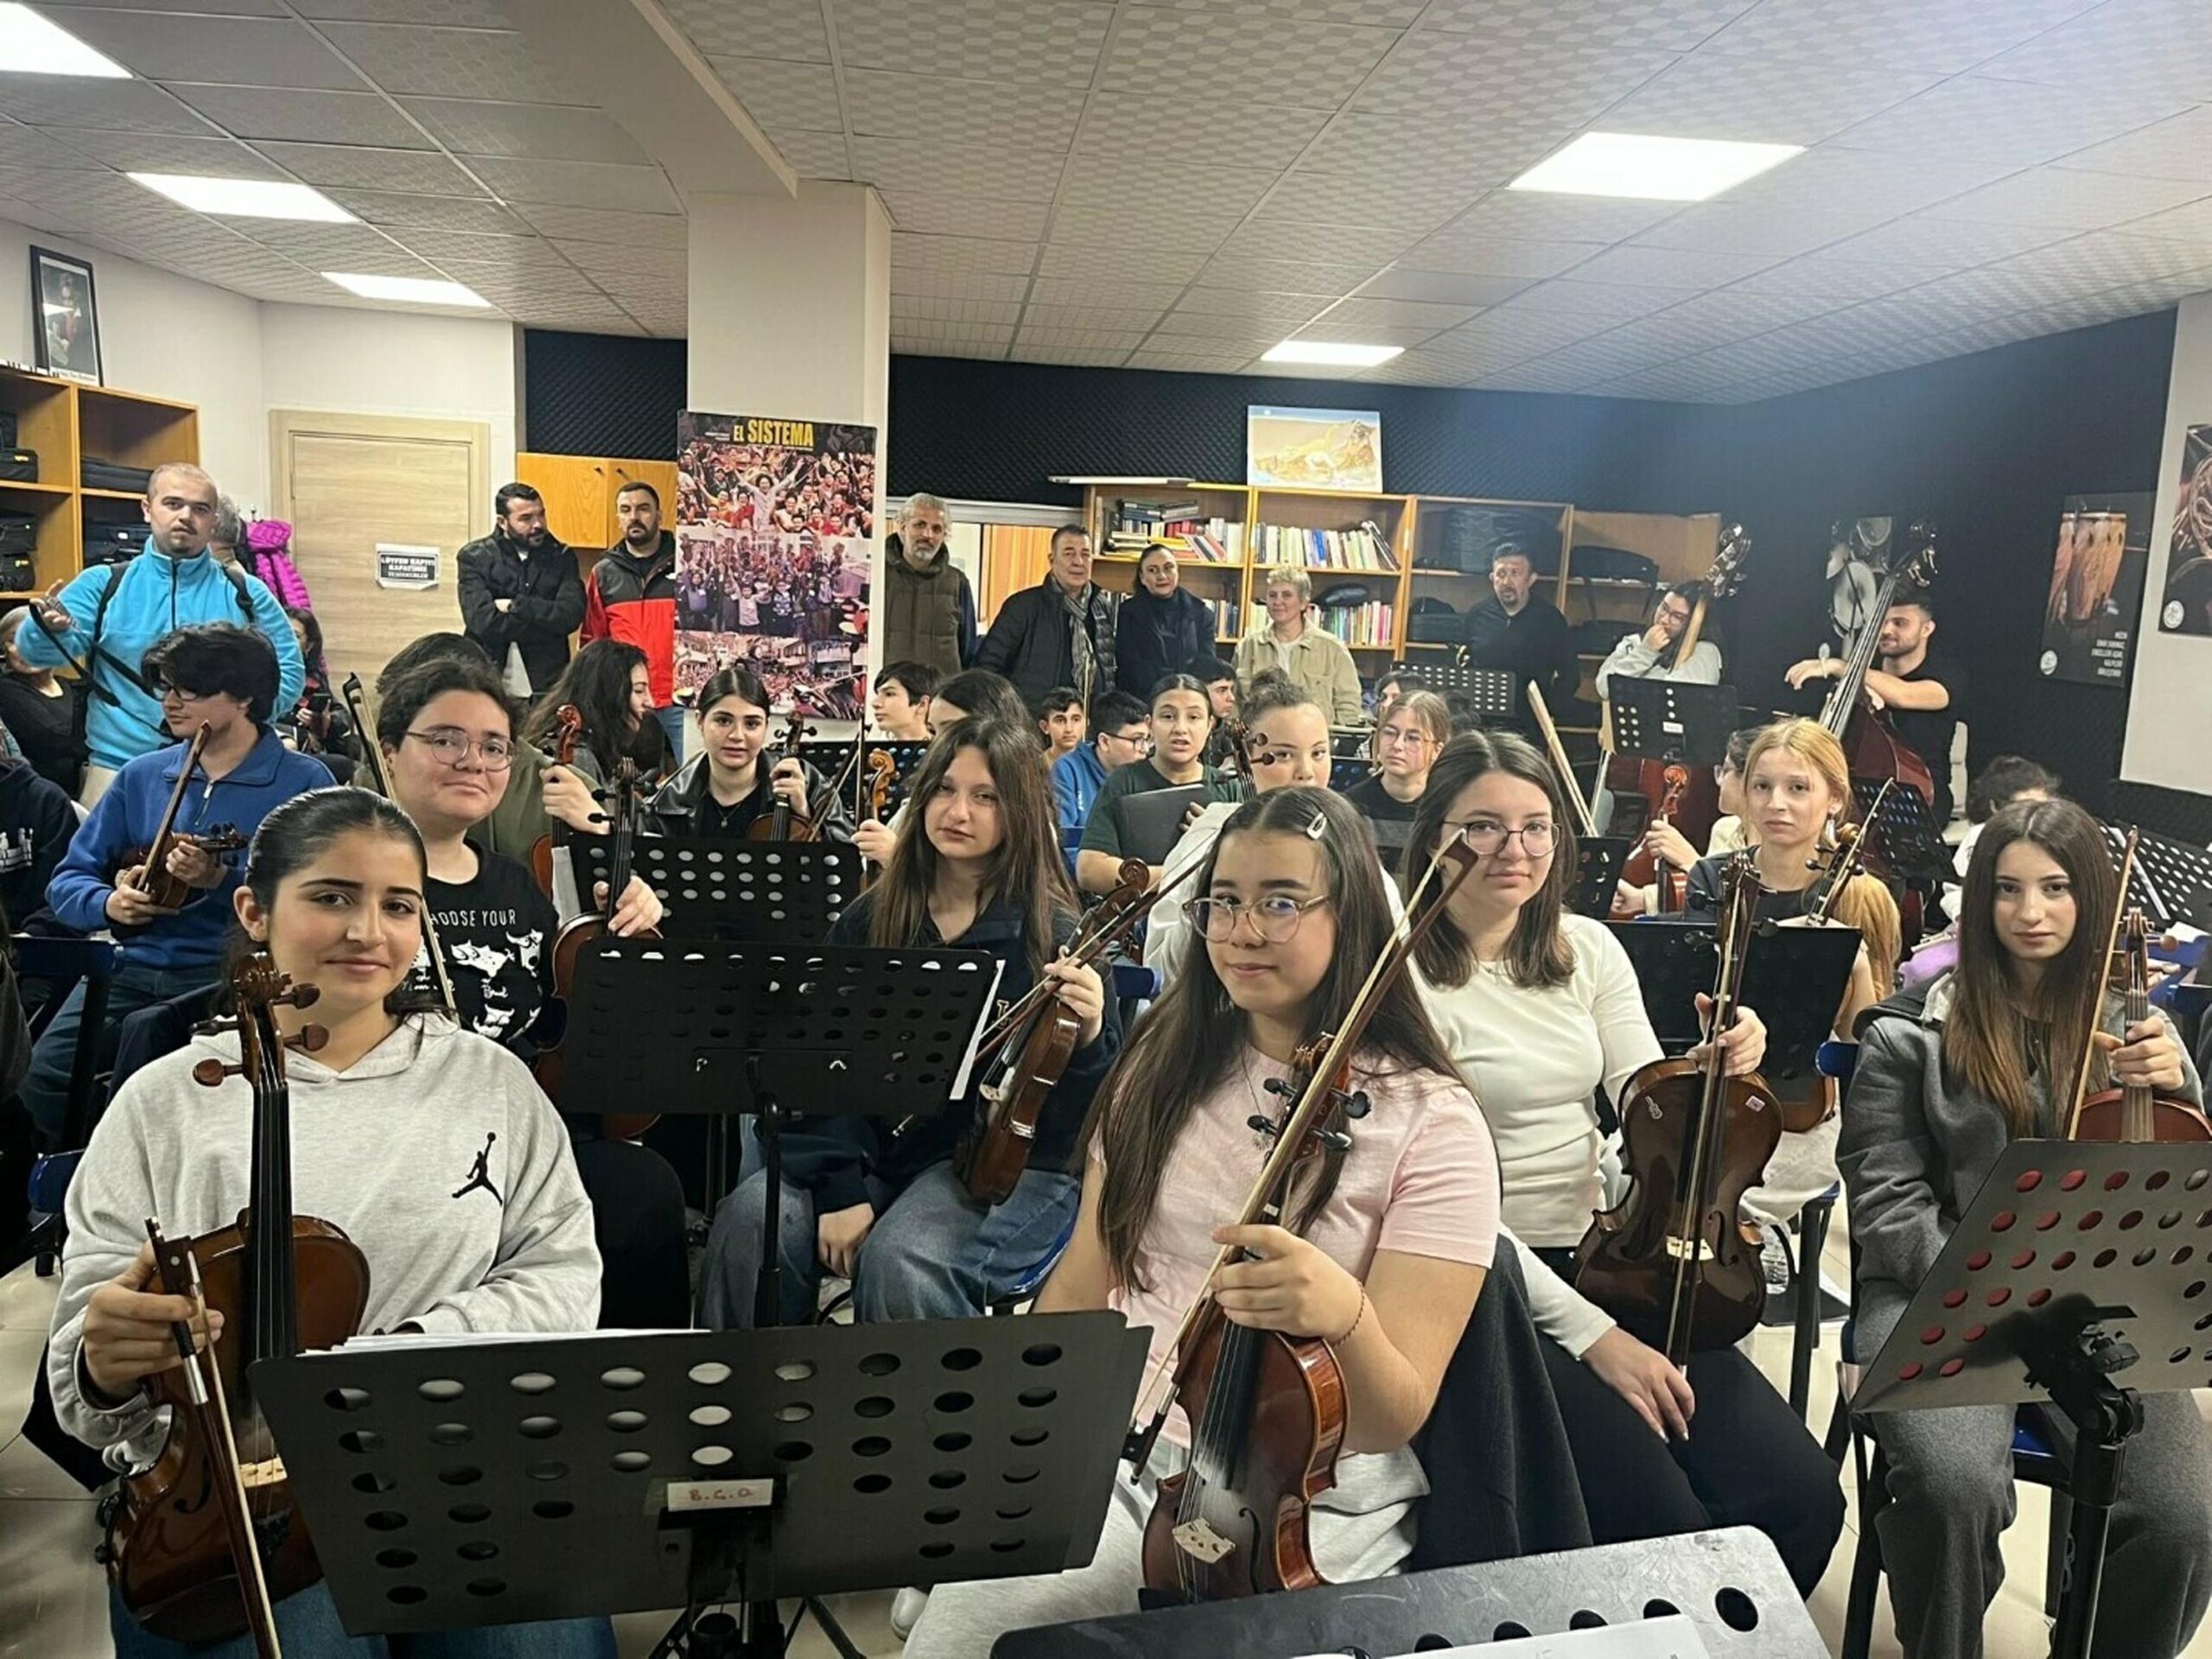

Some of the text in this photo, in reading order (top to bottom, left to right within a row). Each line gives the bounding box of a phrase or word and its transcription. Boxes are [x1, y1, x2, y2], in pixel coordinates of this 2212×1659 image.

[734, 425, 744, 442] EL
[747, 419, 814, 447] SISTEMA
[431, 908, 516, 927] HOOSE YOUR
